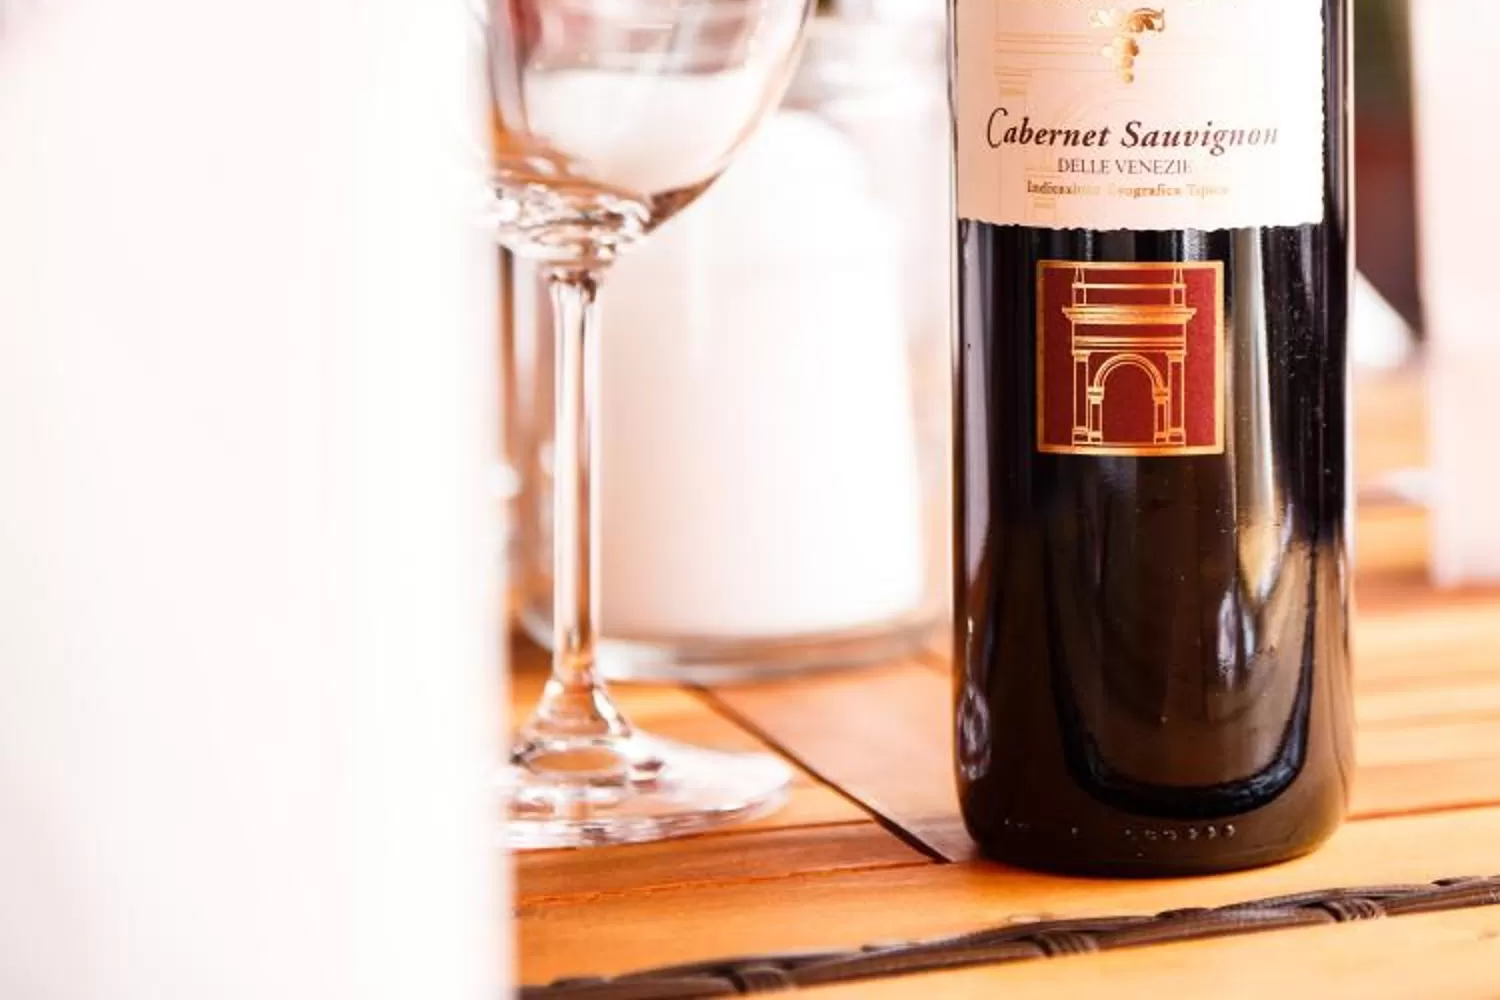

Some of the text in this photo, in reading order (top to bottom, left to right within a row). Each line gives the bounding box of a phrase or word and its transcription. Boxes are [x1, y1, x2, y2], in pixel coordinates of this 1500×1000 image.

[987, 107, 1278, 157] Cabernet Sauvignon
[1057, 157, 1110, 174] DELLE
